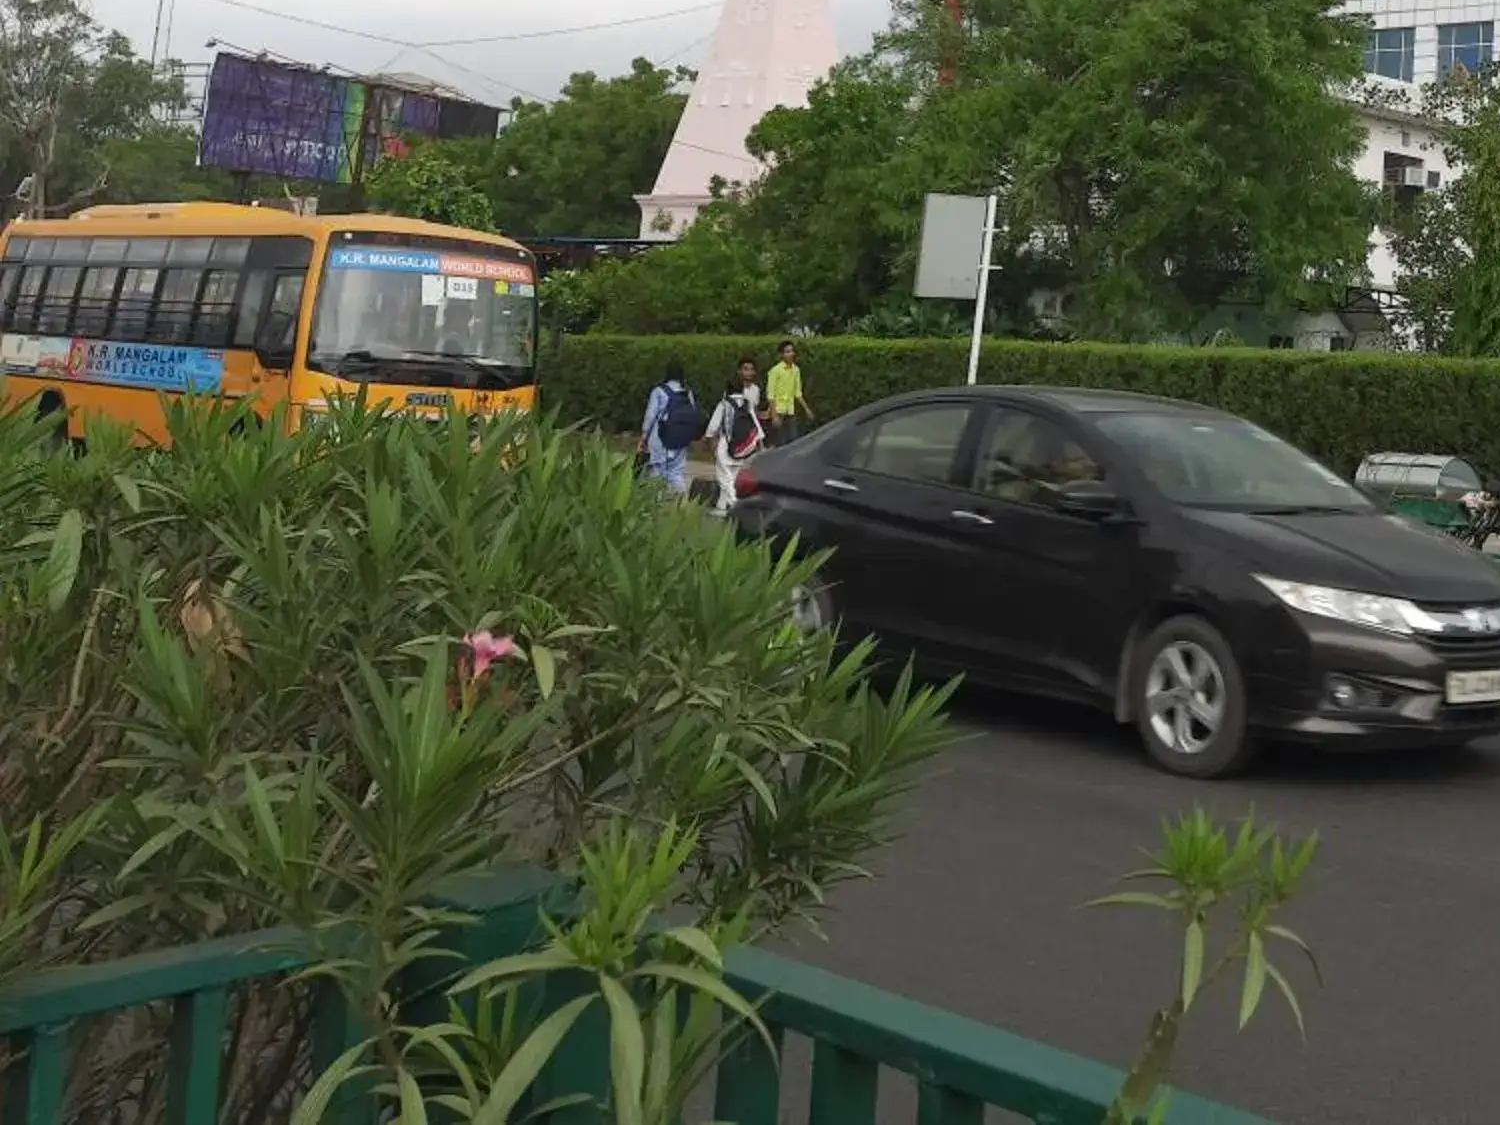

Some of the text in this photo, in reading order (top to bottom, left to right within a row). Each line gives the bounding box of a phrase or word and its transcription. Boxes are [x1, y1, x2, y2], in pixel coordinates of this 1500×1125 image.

[369, 254, 439, 270] MANGALAM
[442, 259, 484, 274] WORLD
[485, 263, 529, 280] SCHOOL
[87, 344, 111, 359] K.R.
[115, 346, 187, 363] MANGALAM
[132, 363, 184, 379] SCHOOL
